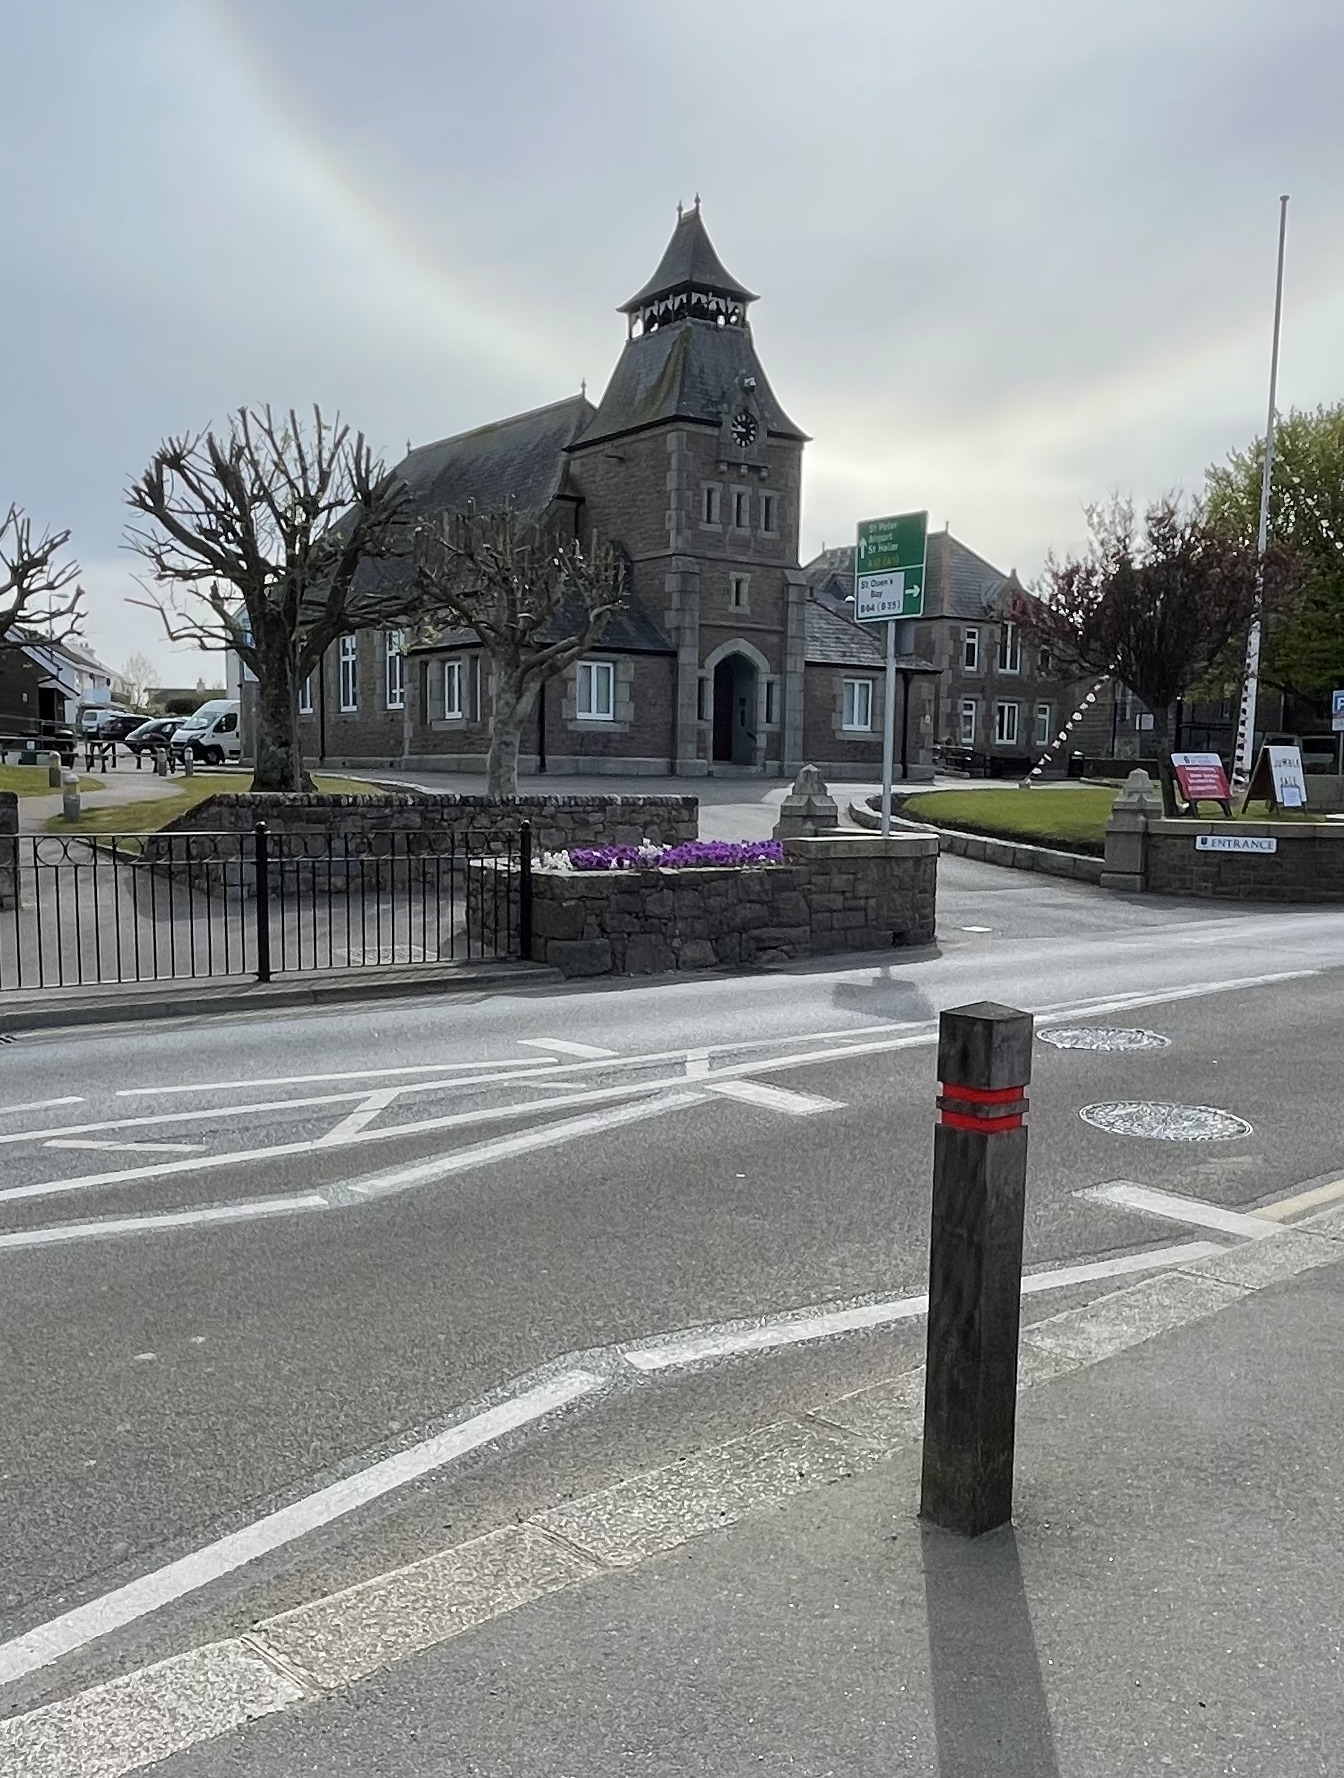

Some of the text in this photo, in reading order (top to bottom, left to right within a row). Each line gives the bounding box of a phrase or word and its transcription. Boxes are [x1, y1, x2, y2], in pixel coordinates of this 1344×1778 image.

[868, 522, 898, 534] St Peter
[868, 532, 893, 544] Airport
[868, 542, 899, 554] St Helier
[860, 578, 893, 590] St Ouen's
[870, 589, 883, 599] Bay
[1280, 776, 1297, 785] SALE
[1211, 837, 1274, 851] ENTRANCE
